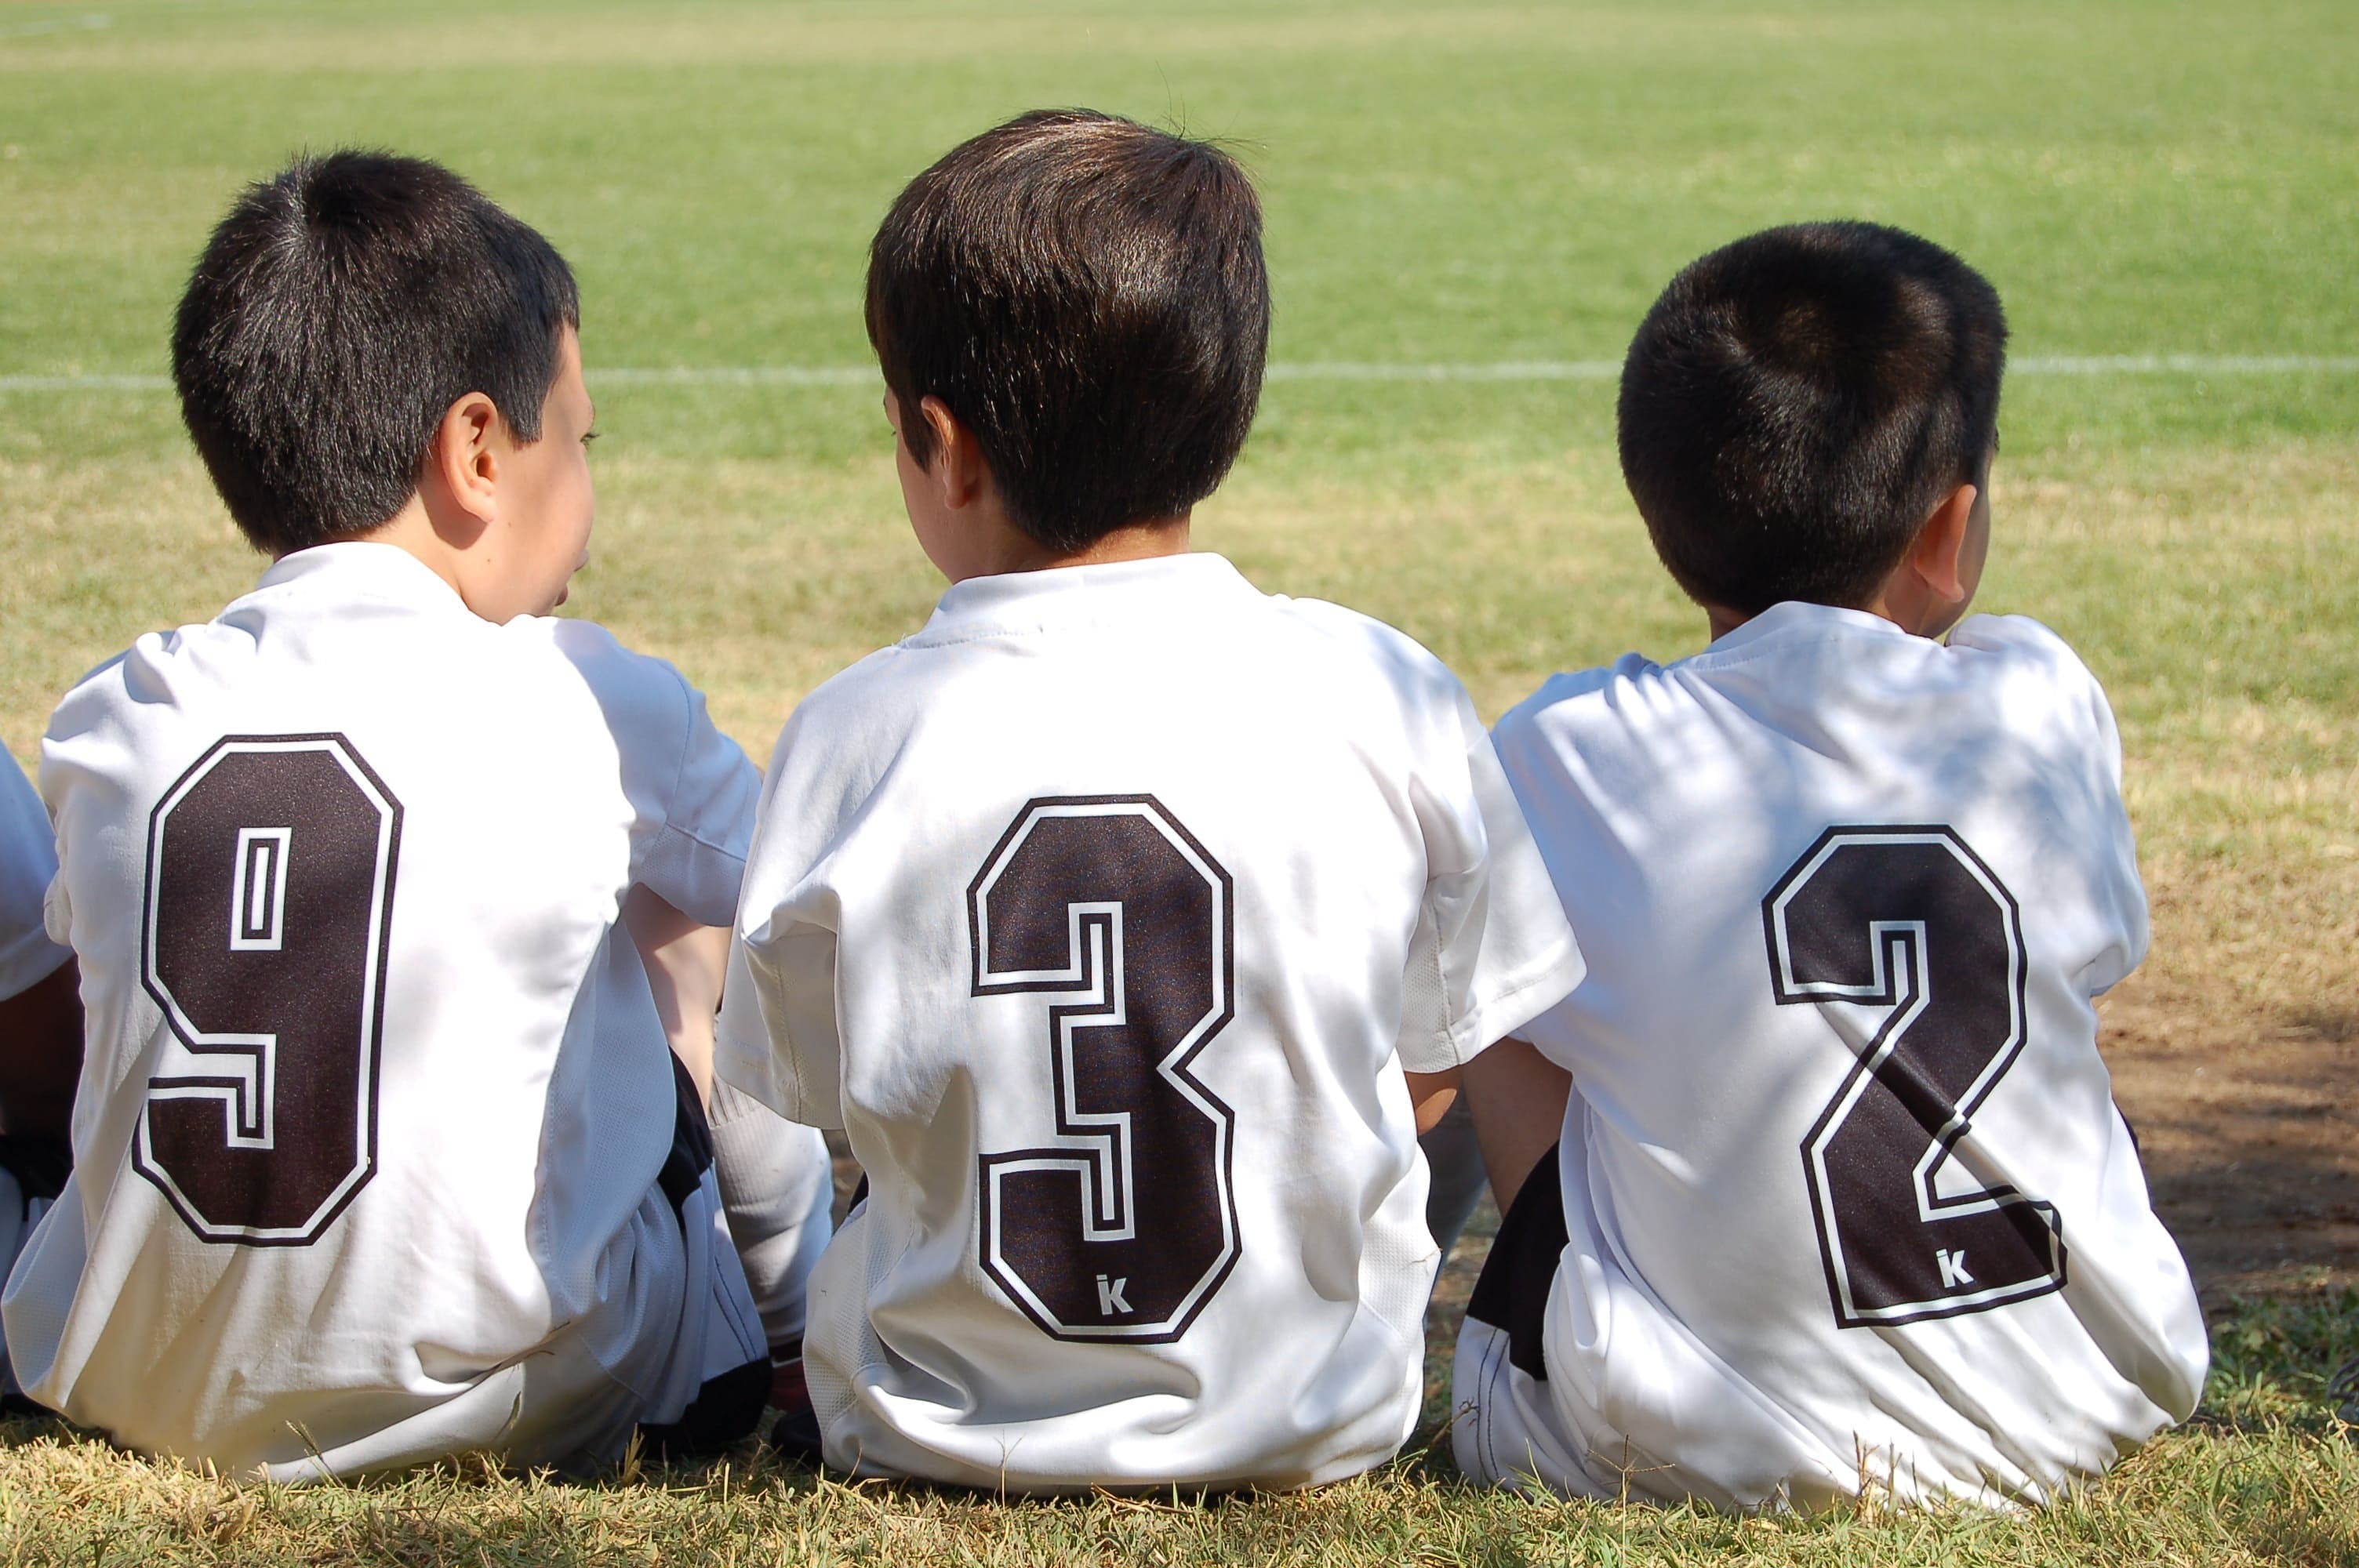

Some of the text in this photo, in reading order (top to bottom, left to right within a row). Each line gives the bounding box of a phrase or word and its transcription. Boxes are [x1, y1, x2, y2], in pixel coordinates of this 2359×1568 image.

[133, 733, 405, 1247] 9
[968, 794, 1241, 1342] 3
[1762, 825, 2068, 1330] 2
